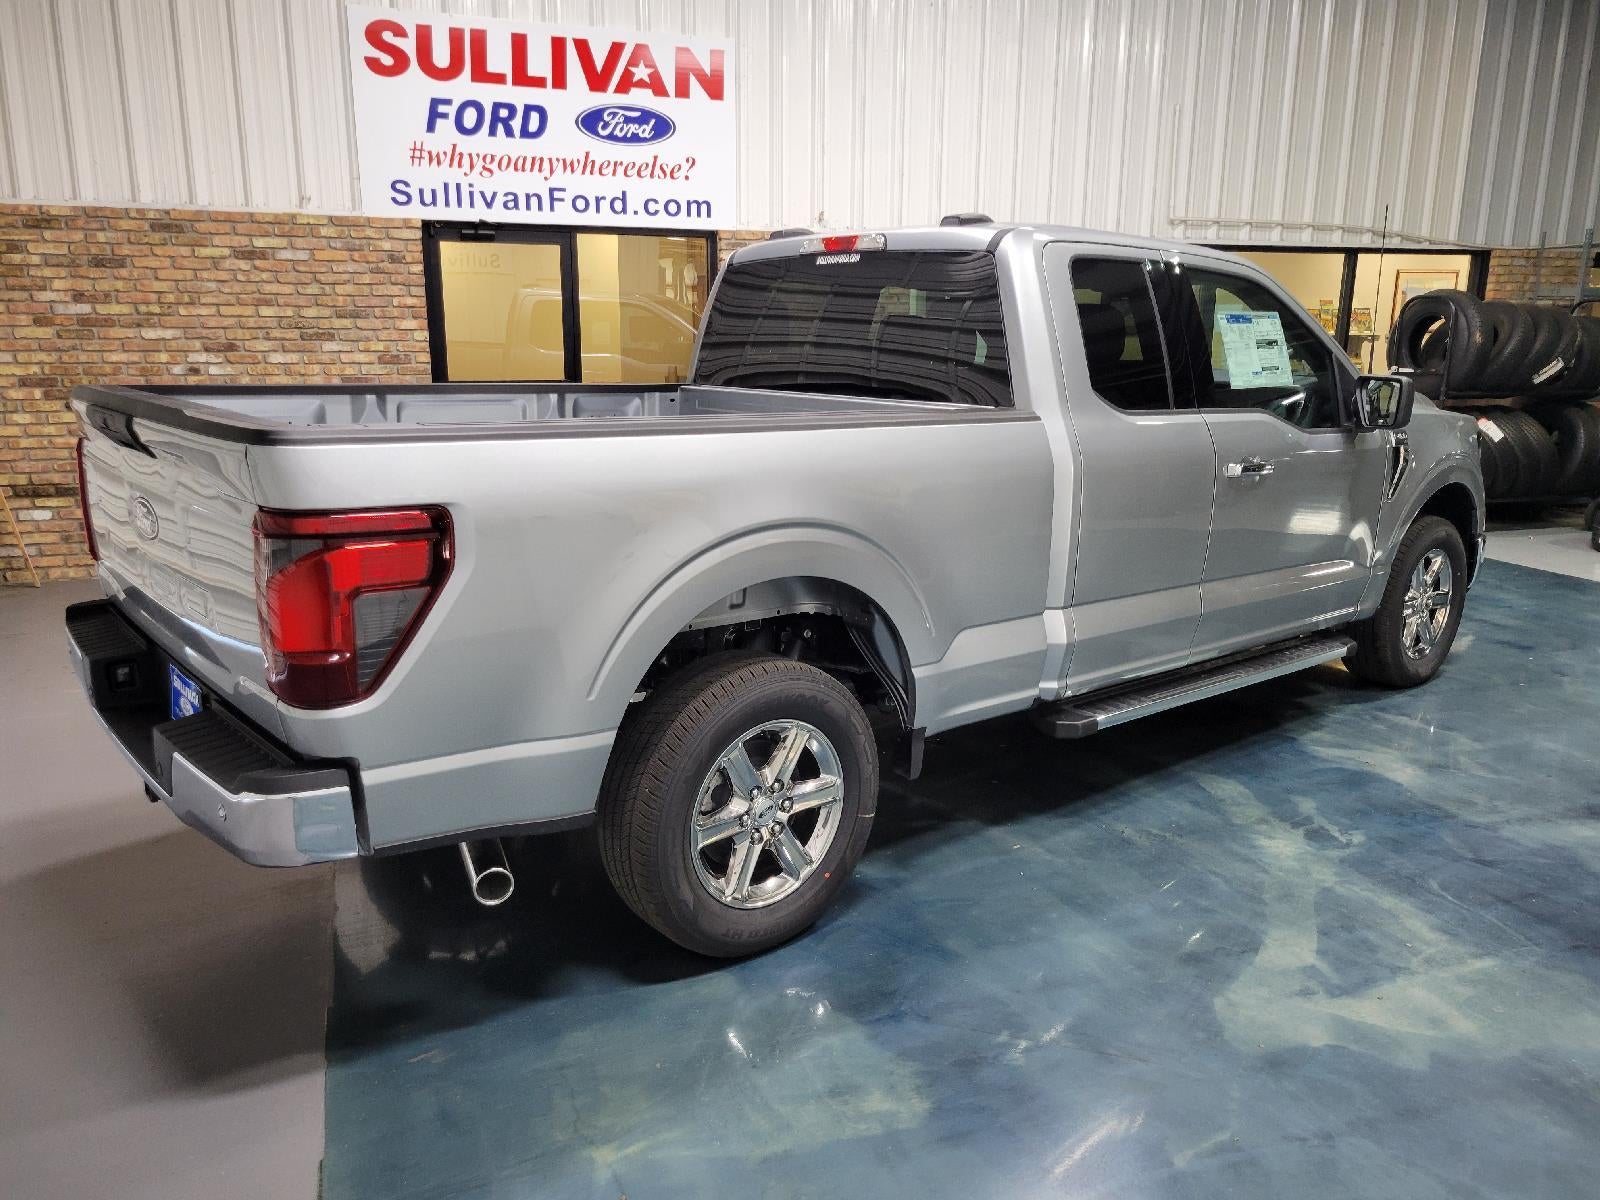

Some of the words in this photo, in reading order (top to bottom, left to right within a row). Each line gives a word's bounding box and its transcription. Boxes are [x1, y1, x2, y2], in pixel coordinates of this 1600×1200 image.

[364, 19, 725, 101] SULLIVAN
[426, 97, 549, 140] FORD
[598, 108, 656, 138] Ford
[409, 140, 696, 181] #whygoanywhereelse?
[390, 179, 712, 218] SullivanFord.com
